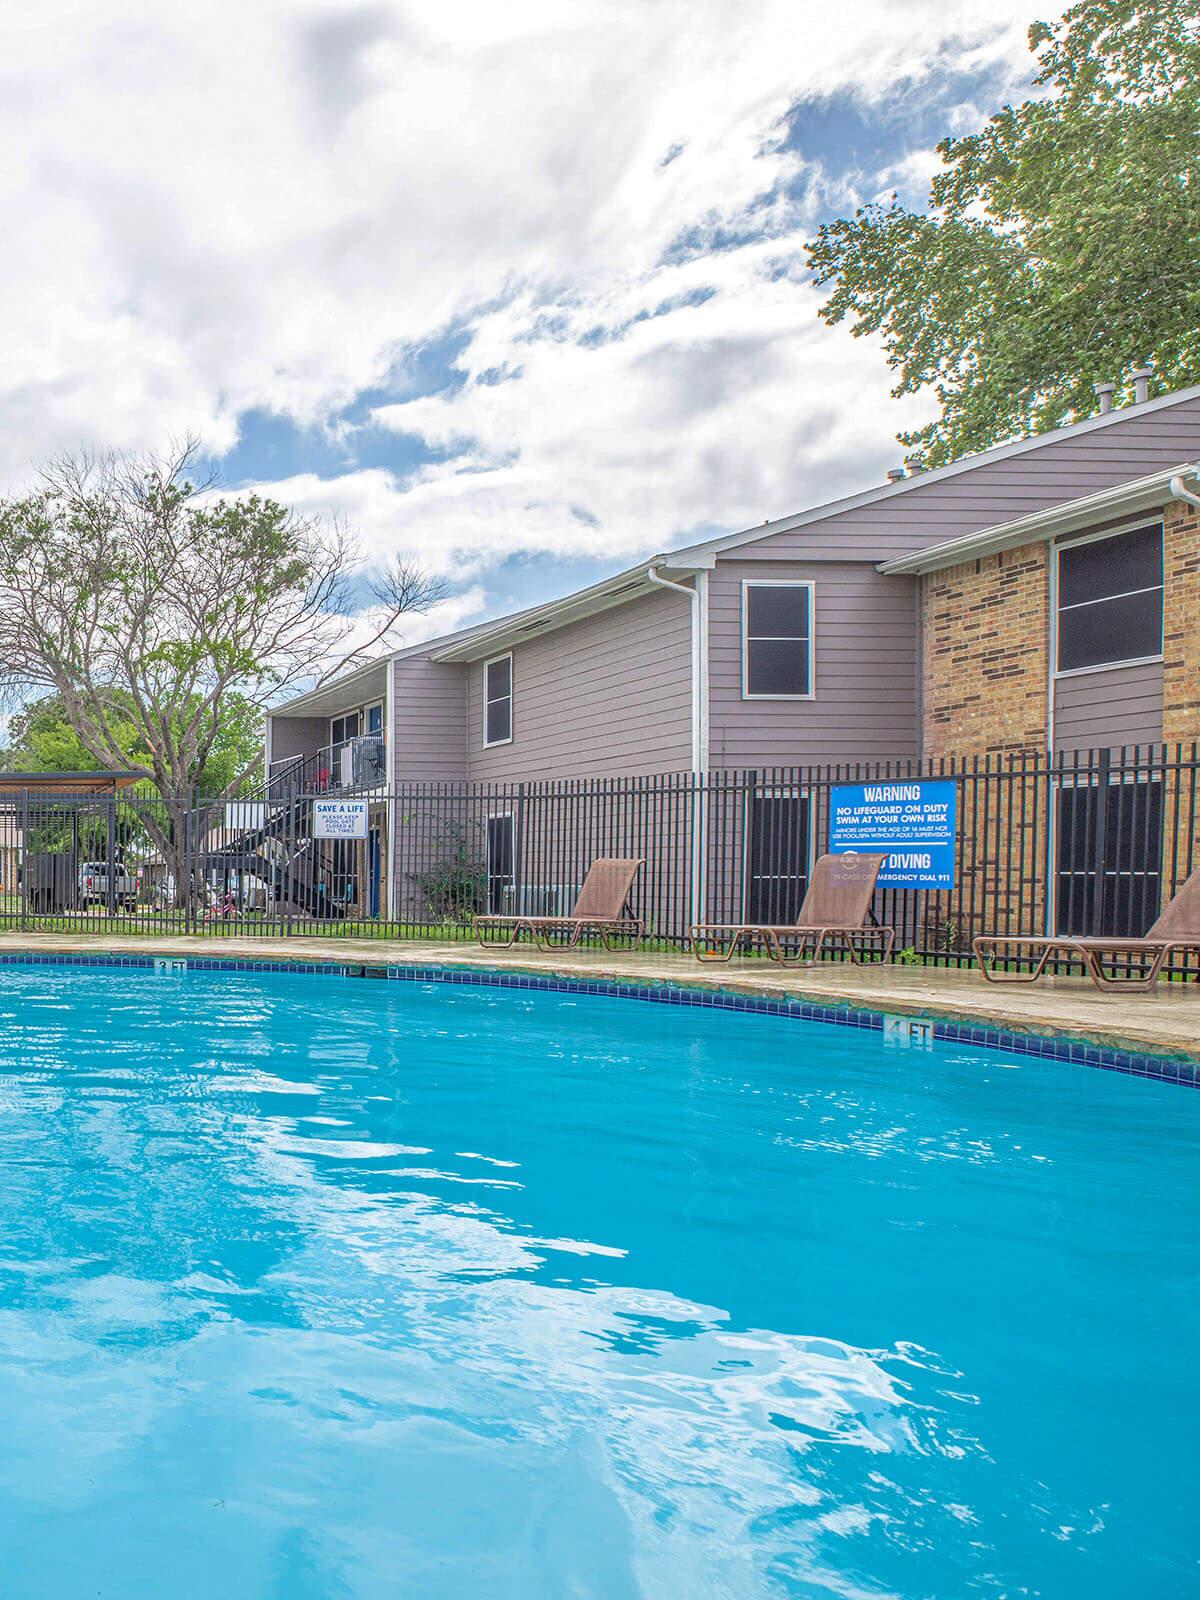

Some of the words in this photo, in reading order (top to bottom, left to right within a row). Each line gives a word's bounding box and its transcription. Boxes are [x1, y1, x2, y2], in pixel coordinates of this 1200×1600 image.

[864, 785, 920, 802] WARNING
[837, 807, 851, 815] NO
[854, 805, 902, 815] LIFEGUARD
[905, 805, 920, 813] ON
[923, 803, 948, 813] DUTY
[836, 816, 859, 825] SWIM
[861, 816, 872, 824] AT
[875, 815, 898, 824] YOUR
[901, 814, 924, 823] OWN
[927, 813, 947, 822] RISK
[889, 853, 931, 869] DIVING
[877, 873, 917, 881] MERGENCY
[919, 873, 936, 881] DIAL
[938, 873, 951, 881] 911
[172, 961, 185, 969] FT
[910, 1022, 930, 1041] FT
